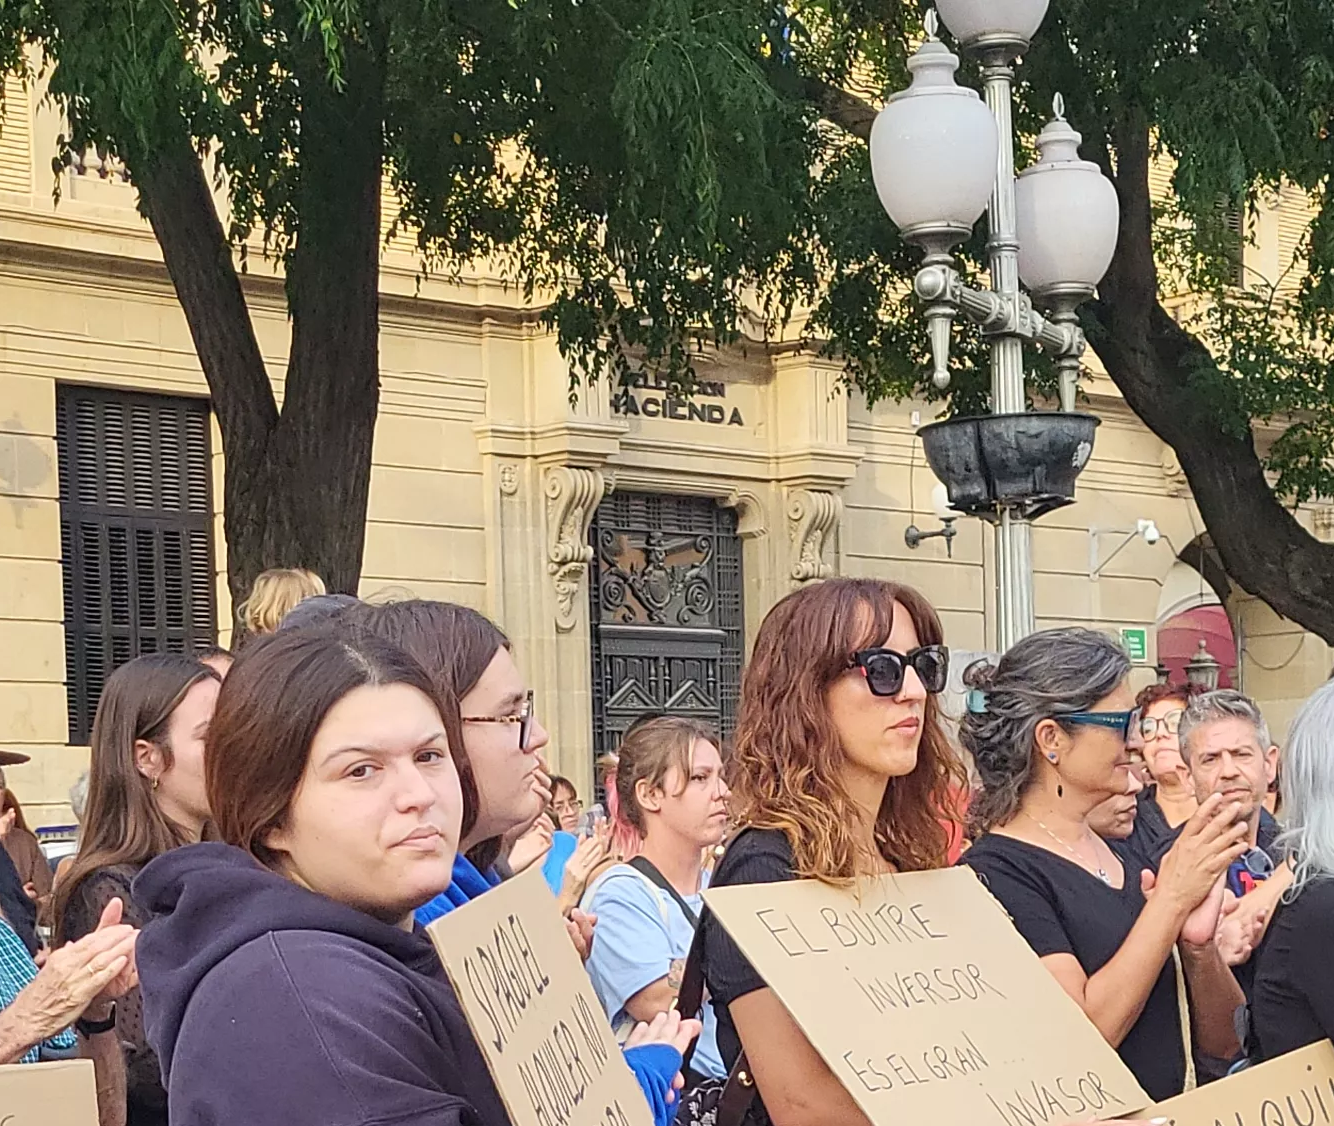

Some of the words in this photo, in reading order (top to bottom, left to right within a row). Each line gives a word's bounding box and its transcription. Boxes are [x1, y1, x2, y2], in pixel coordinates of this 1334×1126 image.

[754, 907, 829, 958] EL
[820, 902, 949, 949] BUITRE
[475, 920, 532, 1034] PAGO
[569, 990, 609, 1077] NO
